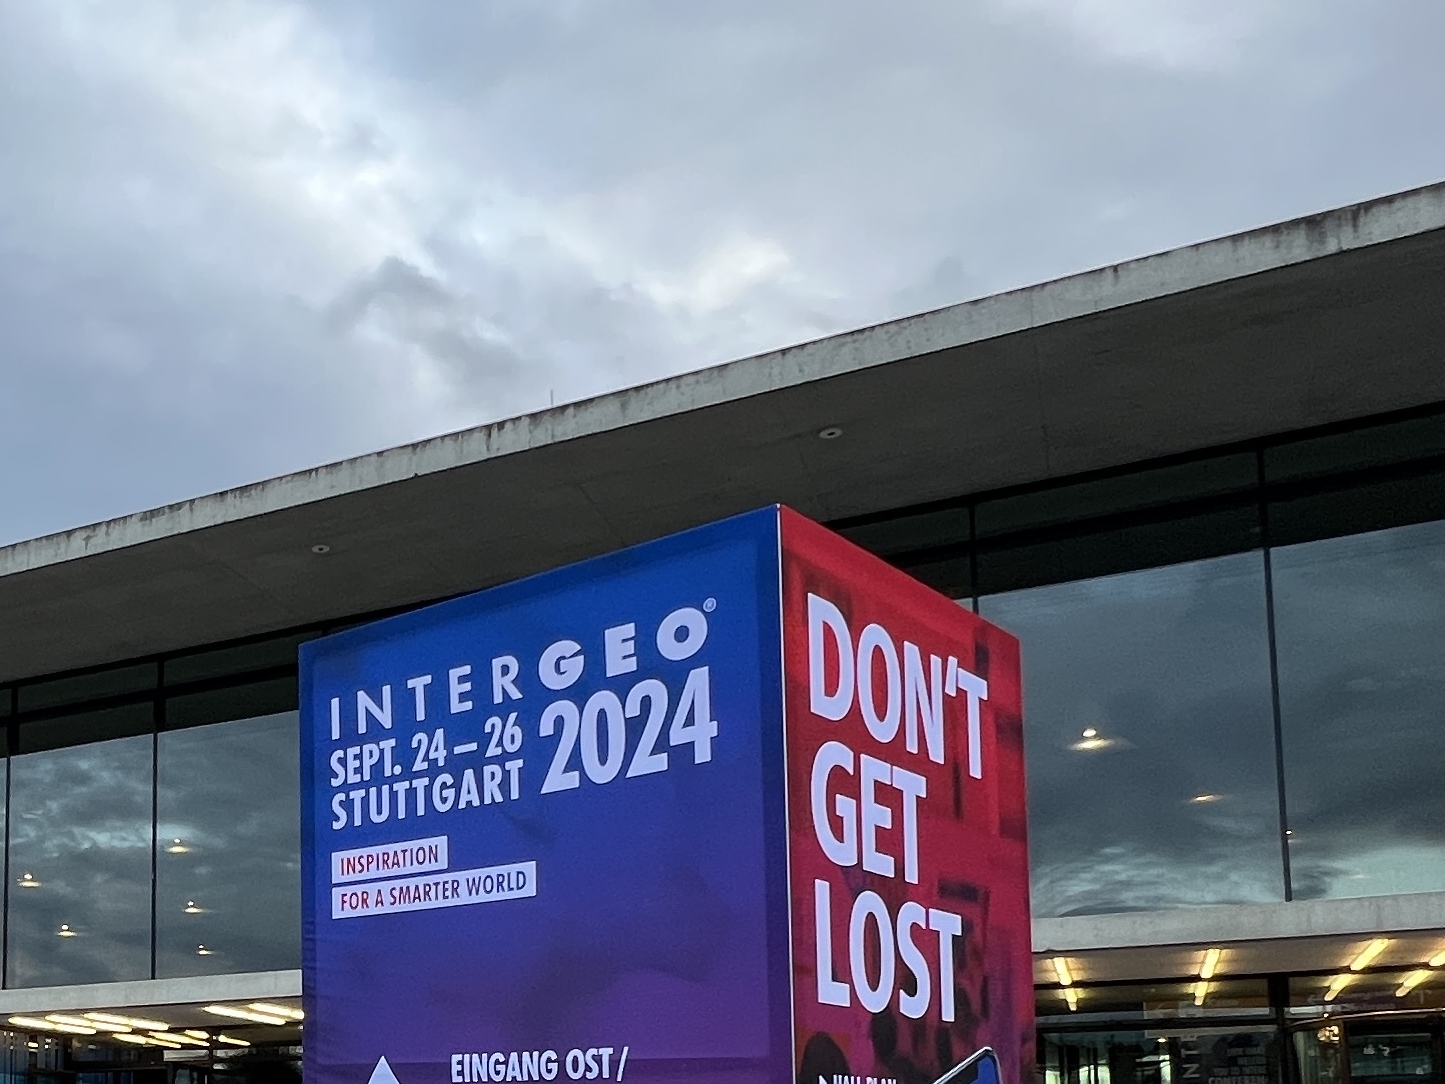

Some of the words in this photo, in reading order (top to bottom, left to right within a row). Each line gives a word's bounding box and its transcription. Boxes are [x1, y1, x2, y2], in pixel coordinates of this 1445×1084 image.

[808, 592, 988, 780] DON'T
[330, 738, 402, 788] SEPT.
[539, 665, 718, 795] 2024
[332, 759, 524, 831] STUTTGART
[811, 740, 927, 885] GET
[340, 844, 439, 876] INSPIRATION
[340, 891, 370, 913] FOR
[374, 889, 385, 908] A
[389, 879, 460, 906] SMARTER
[466, 870, 527, 897] WORLD
[814, 878, 962, 1023] LOST
[451, 1050, 558, 1083] EINGANG
